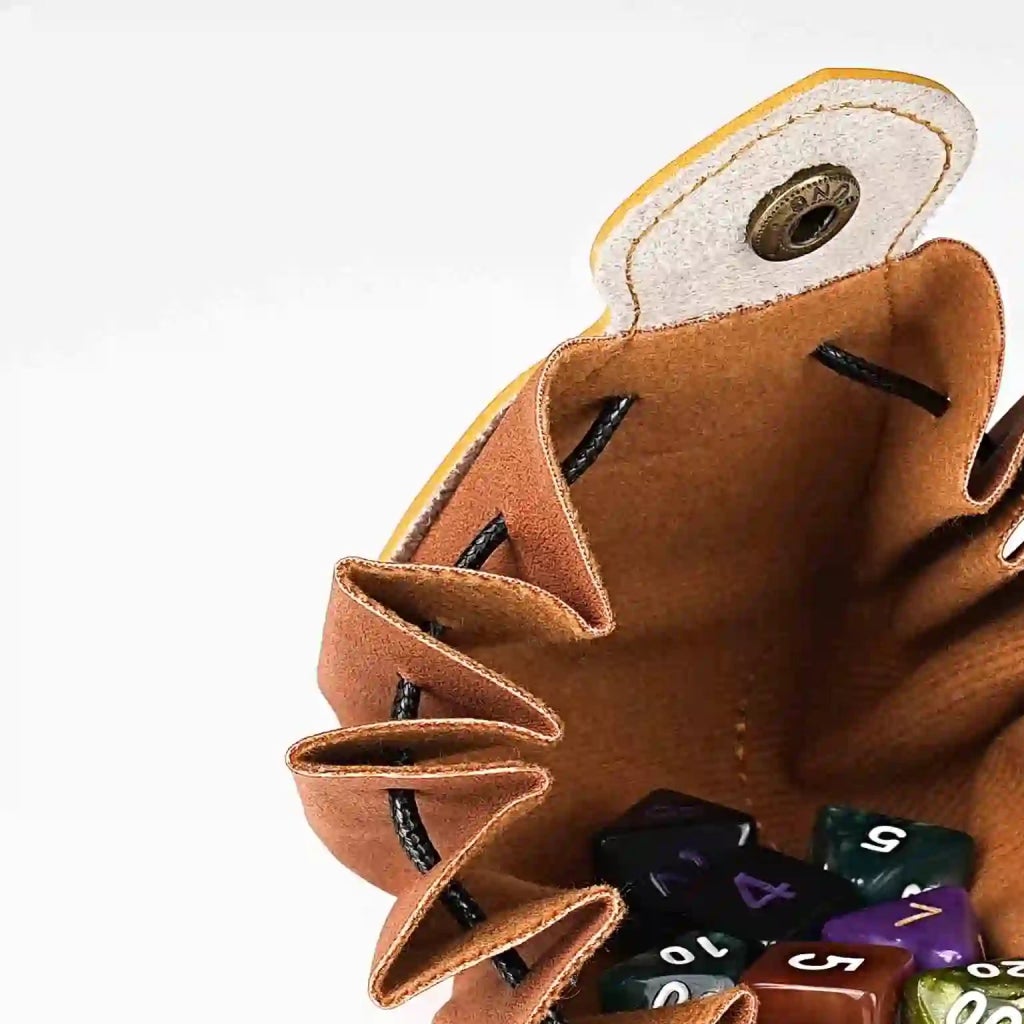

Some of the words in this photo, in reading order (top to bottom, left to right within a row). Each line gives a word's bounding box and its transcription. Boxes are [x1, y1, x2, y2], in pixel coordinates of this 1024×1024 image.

[860, 825, 907, 853] 5
[660, 936, 728, 965] 10
[788, 954, 865, 972] 5
